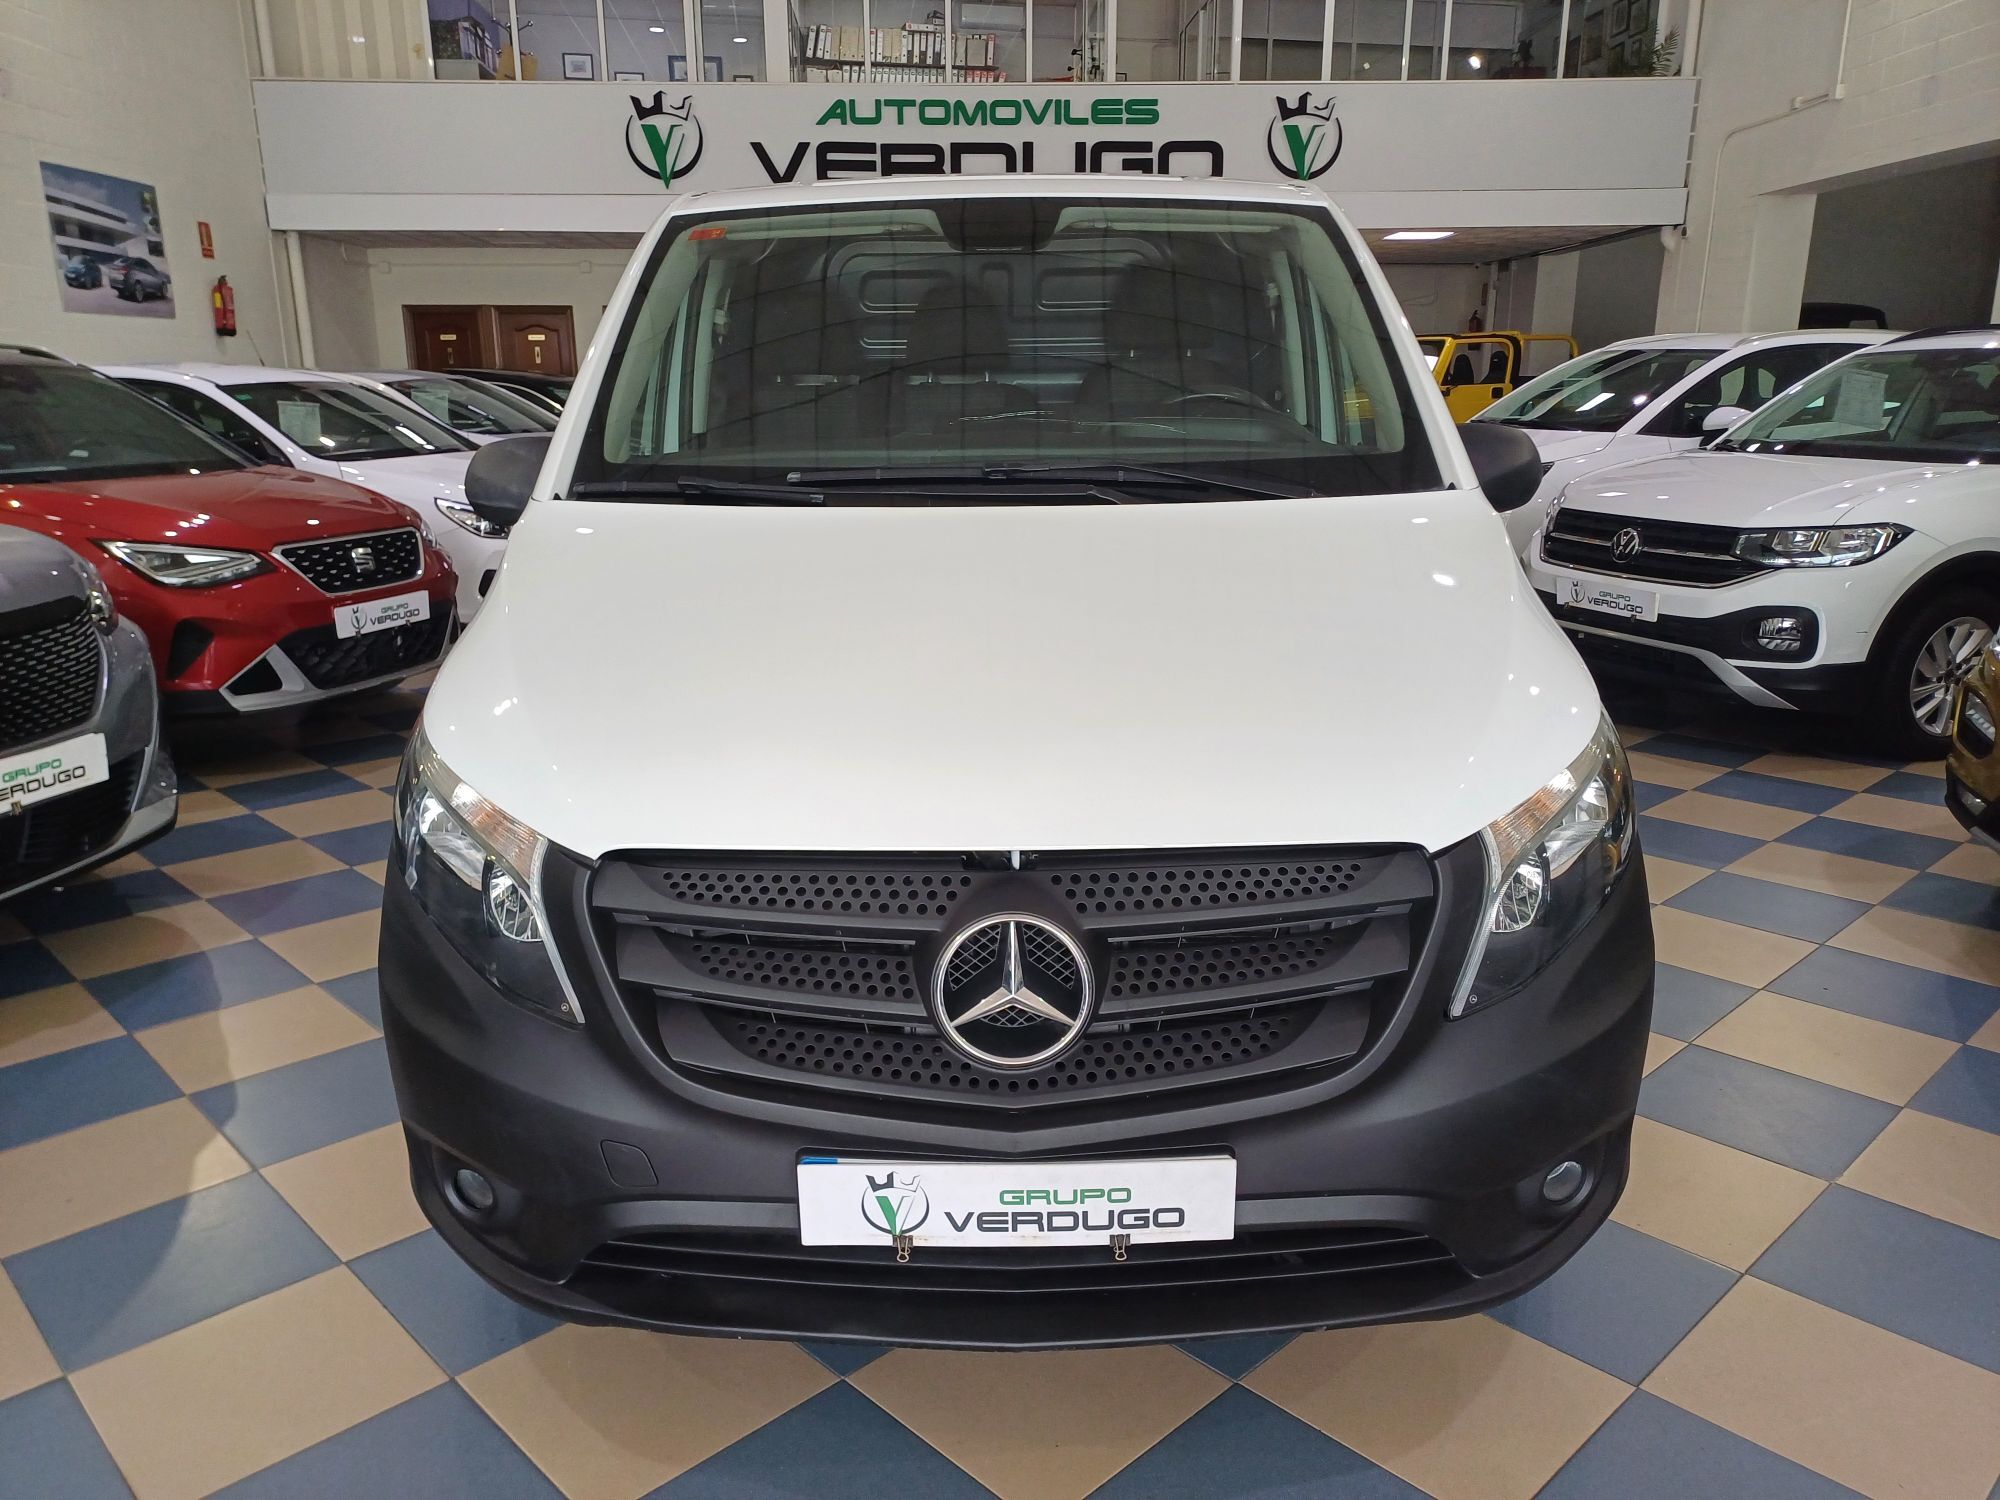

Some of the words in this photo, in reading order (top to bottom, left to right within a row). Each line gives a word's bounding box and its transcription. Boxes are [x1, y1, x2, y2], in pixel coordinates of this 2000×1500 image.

[815, 98, 1160, 126] AUTOMOVILES
[1587, 596, 1643, 614] VERDUGO
[1599, 591, 1631, 602] GRUPO
[370, 608, 420, 625] VERDUGO
[380, 603, 409, 614] GRUPO
[2, 758, 62, 783] GRUPO
[0, 766, 86, 801] ERDUGO
[999, 1187, 1132, 1206] GRUPO
[944, 1206, 1185, 1233] VERDUGO
